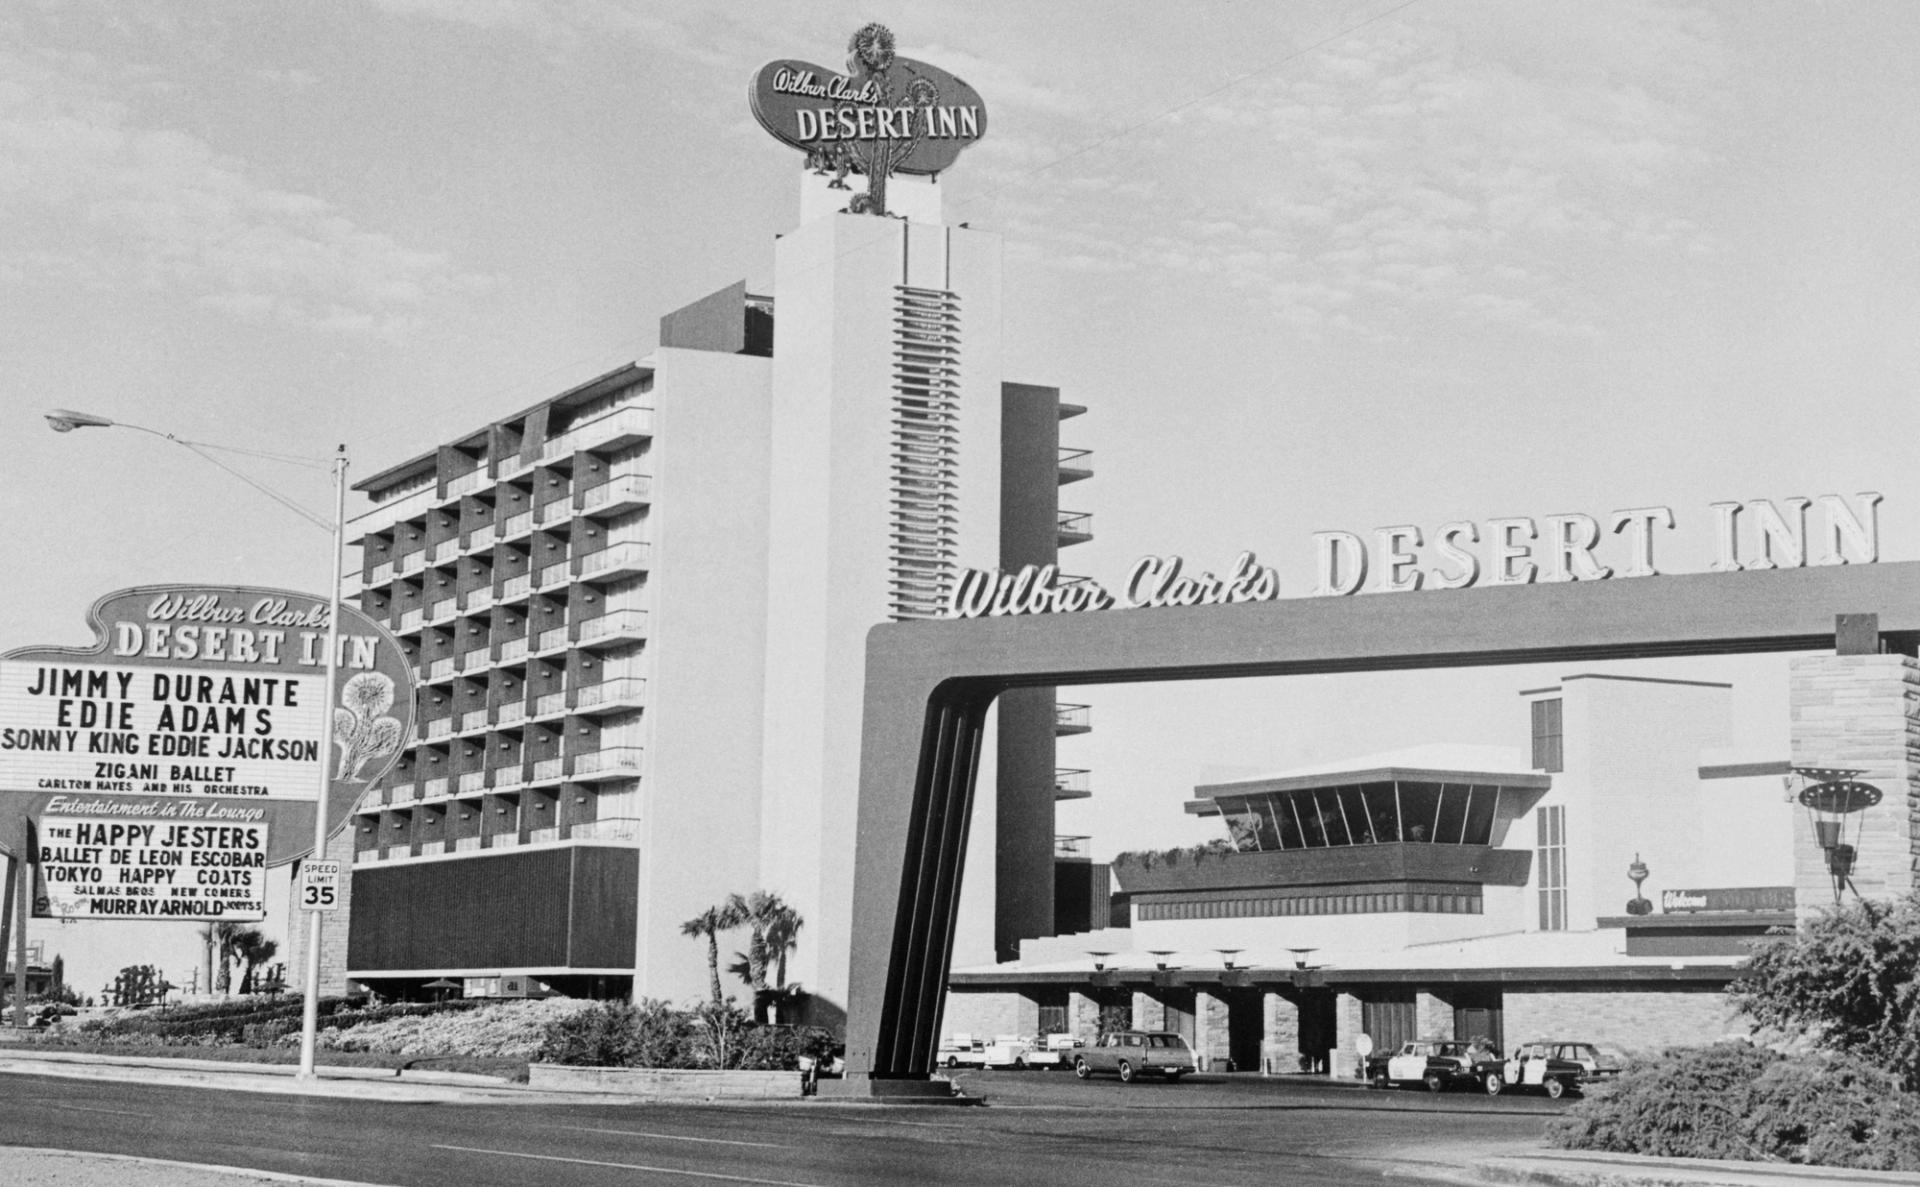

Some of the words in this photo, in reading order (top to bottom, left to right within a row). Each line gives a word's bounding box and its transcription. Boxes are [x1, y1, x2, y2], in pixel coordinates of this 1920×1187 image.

[773, 67, 826, 97] Wilbur
[796, 106, 914, 141] DESERT
[925, 106, 980, 139] INN
[949, 564, 1115, 618] Wilbur
[1126, 551, 1280, 608] Clark's
[1310, 506, 1675, 597] DESERT
[1710, 492, 1883, 571] INN
[148, 594, 246, 624] Wilbur
[113, 621, 287, 665] DESERT
[298, 631, 380, 670] INN
[28, 667, 134, 700] JIMMY
[153, 672, 300, 708] DURANTE
[57, 699, 135, 731] EDIE
[157, 704, 273, 736] ADAMS
[1, 727, 78, 752] SONNY
[88, 731, 140, 755] KING
[148, 734, 211, 758] EDDIE
[217, 737, 319, 762] JACKSON
[94, 761, 158, 780] ZIGANI
[170, 765, 236, 783] BALLET
[38, 778, 91, 790] CARLTON
[96, 781, 133, 792] HAYES
[143, 782, 167, 793] AND
[173, 783, 192, 793] HIS
[204, 784, 269, 796] ORCHESTRA
[44, 795, 159, 817] Entertainment
[158, 802, 177, 817] in
[178, 800, 205, 818] The
[205, 801, 266, 822] Lounge
[49, 827, 72, 839] THE
[76, 823, 155, 847] HAPPY
[161, 825, 260, 850] JESTERS
[41, 846, 103, 865] BALLET
[110, 848, 132, 865] DE
[139, 849, 182, 866] LEON
[190, 850, 265, 868] ESCOBAR
[304, 864, 338, 874] SPEED
[45, 865, 102, 883] TOKYO
[119, 867, 176, 884] HAPPY
[197, 868, 252, 887] COATS
[307, 875, 333, 885] LIMIT
[125, 886, 155, 897] BROS
[171, 887, 198, 898] NEW
[204, 887, 252, 899] COMERS
[305, 885, 335, 905] 35
[90, 897, 158, 915] MURRAY
[158, 898, 224, 916] ARNOLD
